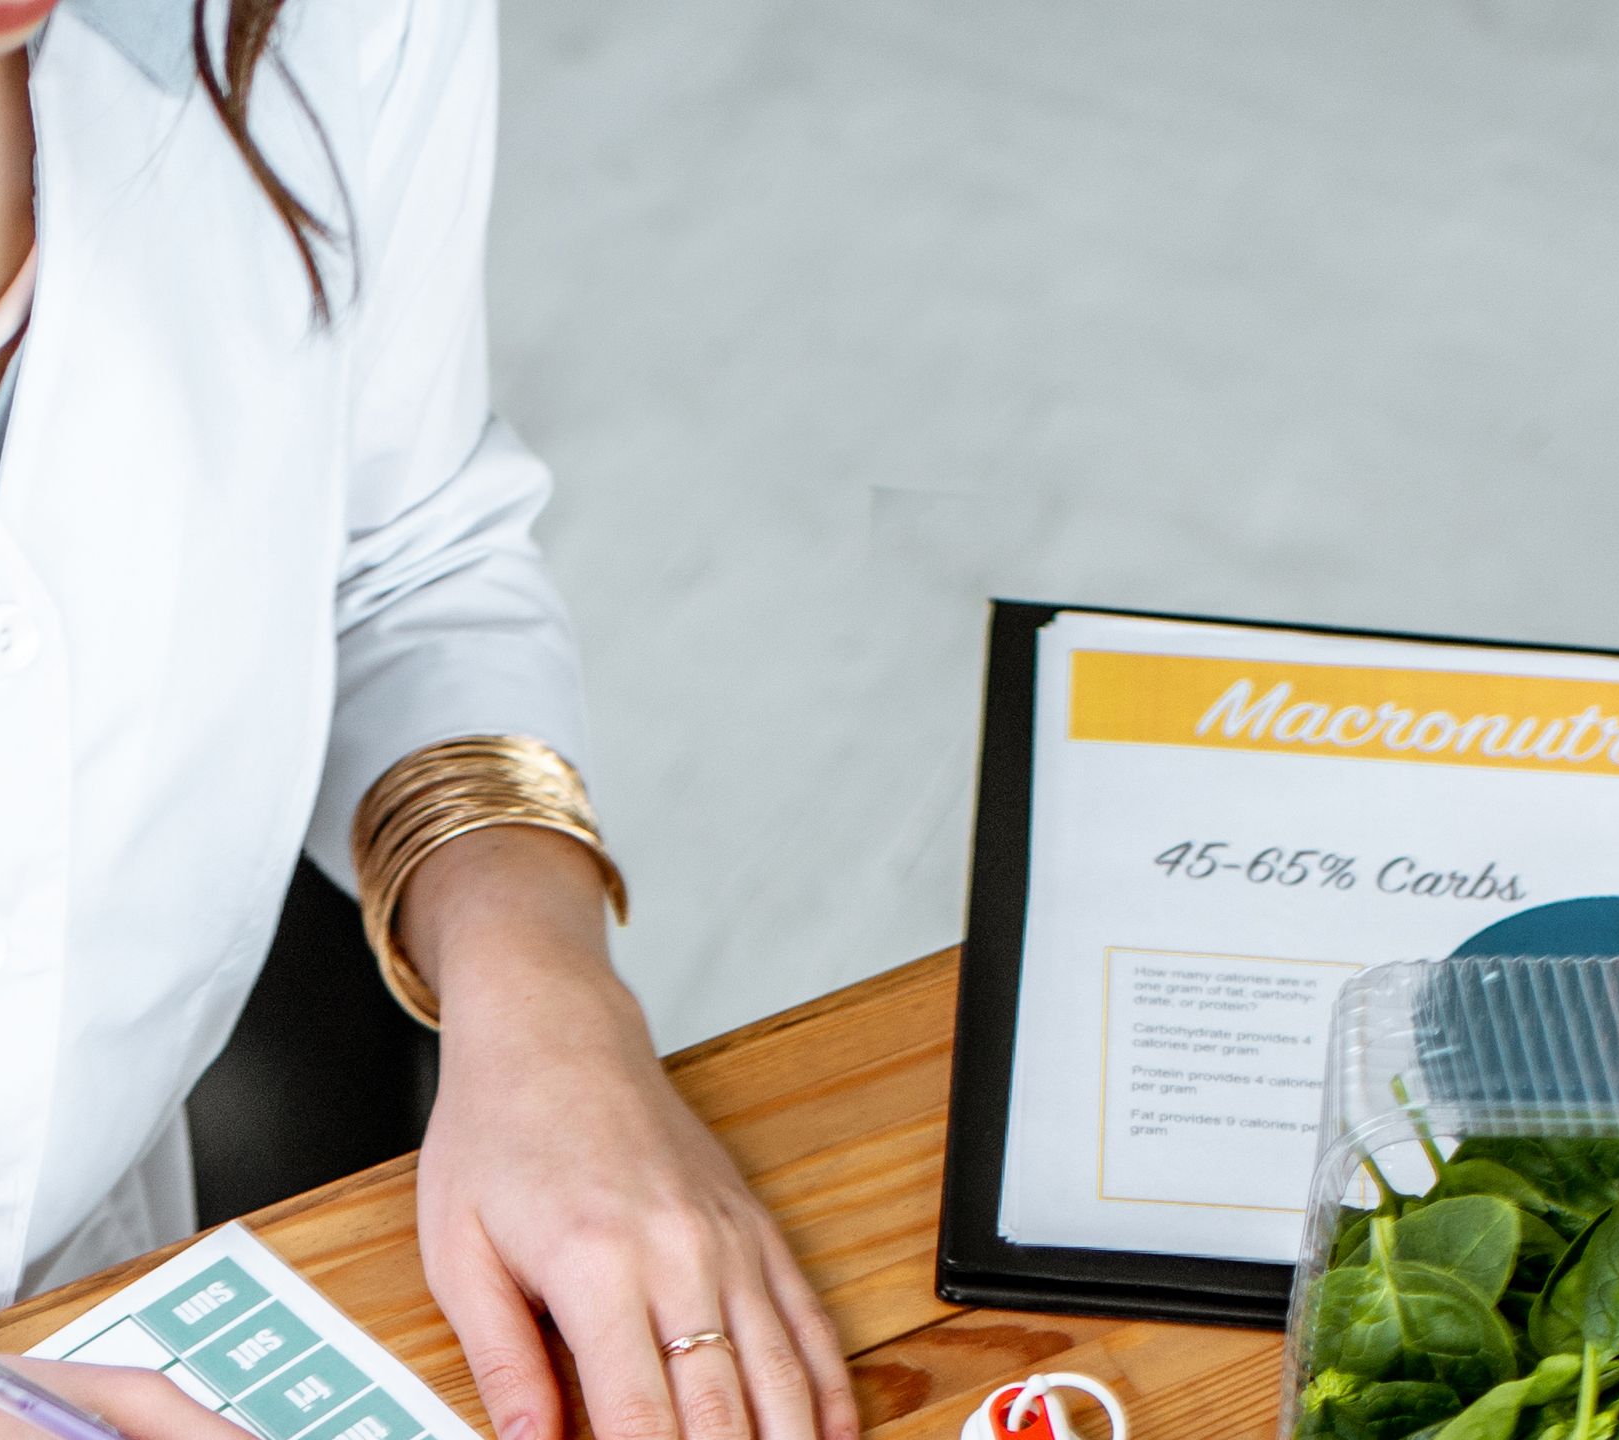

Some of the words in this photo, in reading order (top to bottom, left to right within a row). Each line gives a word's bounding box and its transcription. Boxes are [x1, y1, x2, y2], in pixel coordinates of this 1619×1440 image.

[1154, 841, 1355, 889] 45-65%
[1376, 856, 1525, 901] Carbs
[1134, 967, 1166, 977] How
[1171, 970, 1211, 982] many
[1215, 973, 1271, 984] calories
[1276, 978, 1299, 986] are
[1304, 979, 1316, 987] in
[1132, 1022, 1231, 1039] Carbohydrate
[1236, 1032, 1298, 1044] provides
[1302, 1036, 1310, 1044] 4
[1132, 1038, 1188, 1050] calories
[1193, 1043, 1217, 1052] per
[1221, 1045, 1258, 1055] gram
[1131, 1082, 1155, 1091] per
[1159, 1084, 1196, 1094] gram
[172, 1281, 235, 1324] sun
[227, 1328, 282, 1370] sut
[284, 1375, 331, 1411] fri
